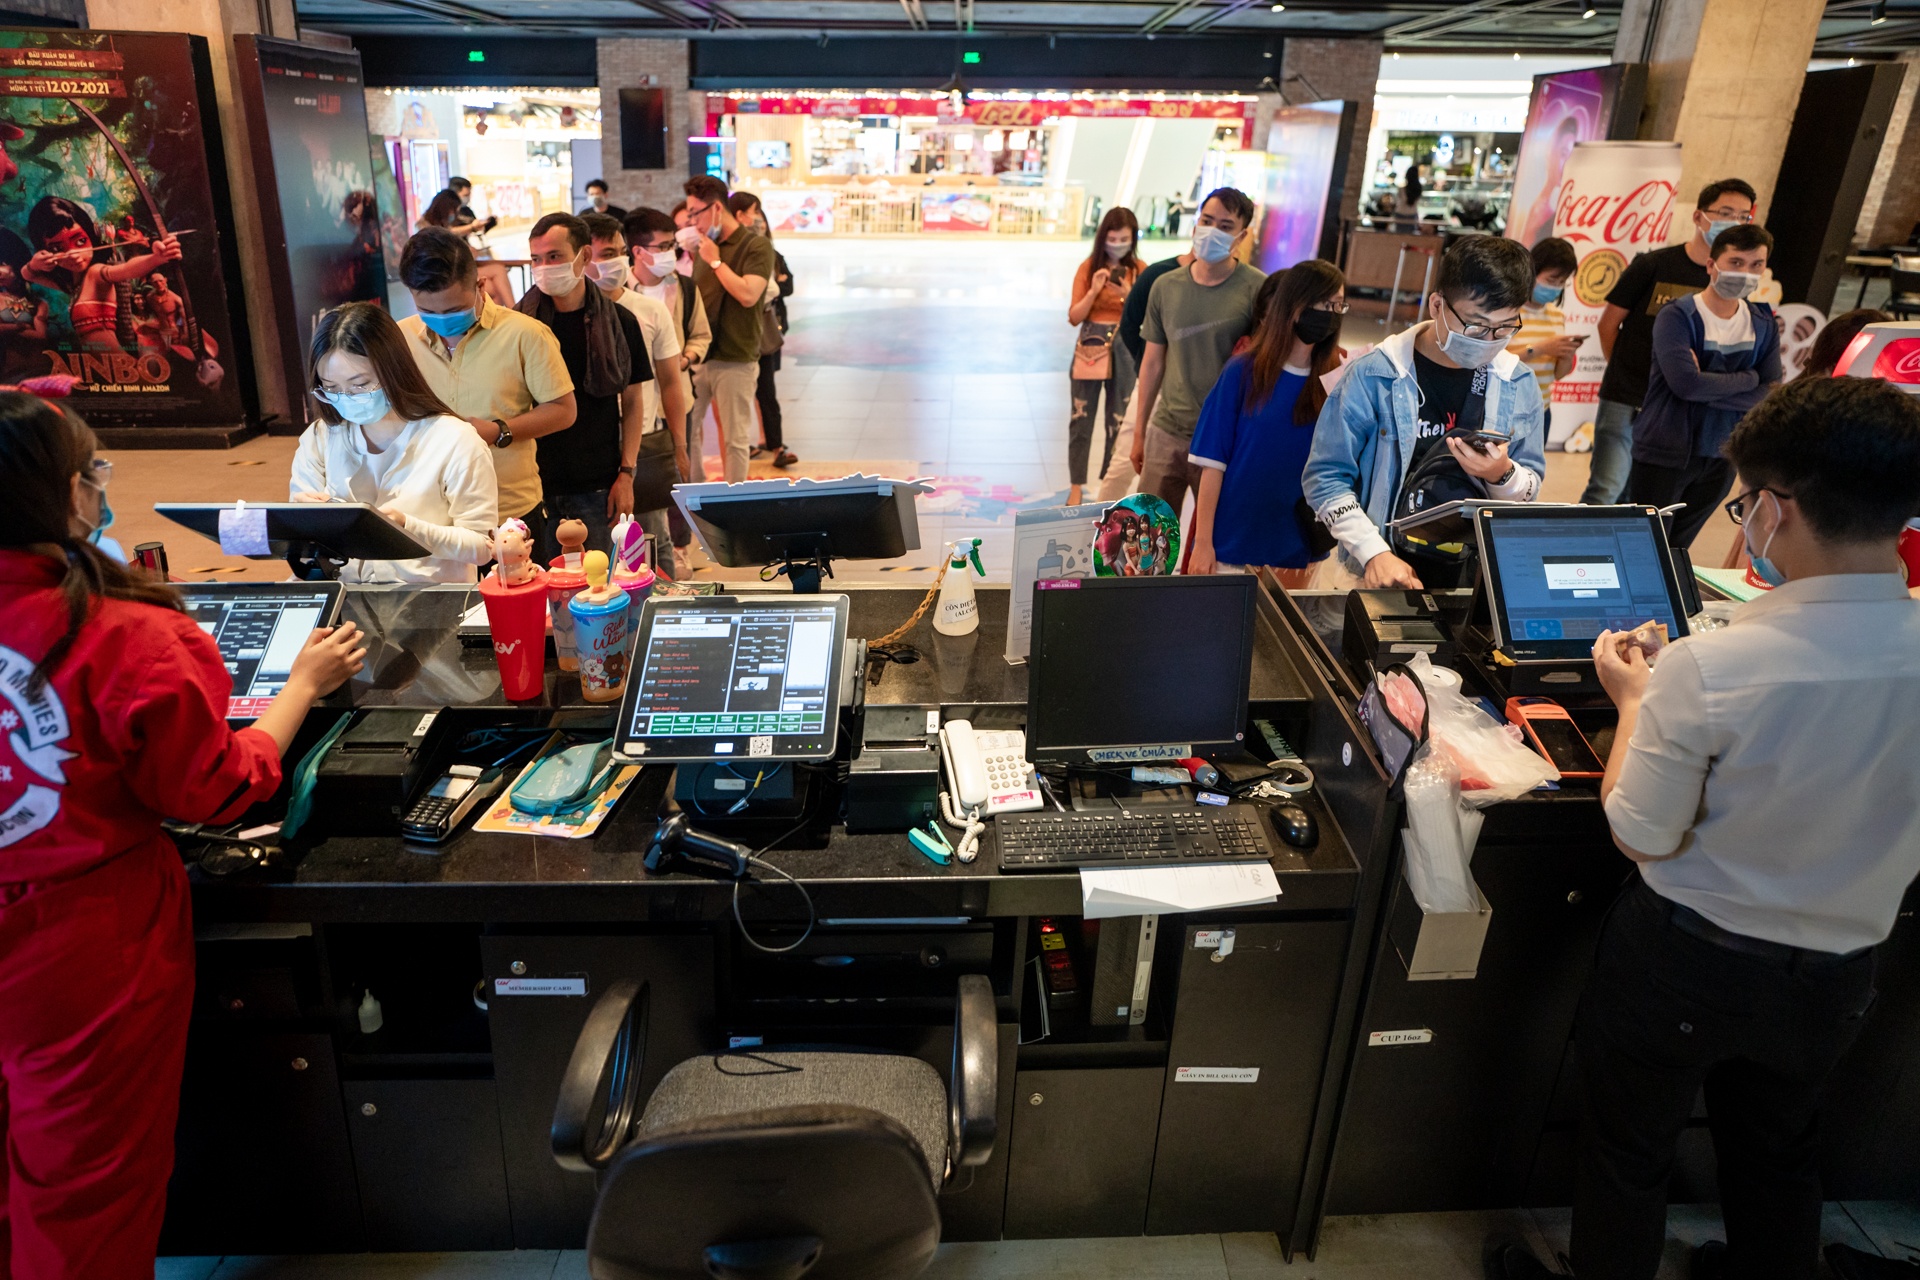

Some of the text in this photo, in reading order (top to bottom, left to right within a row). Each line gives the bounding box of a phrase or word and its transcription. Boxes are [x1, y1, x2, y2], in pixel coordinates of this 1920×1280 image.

[46, 80, 110, 94] 12.02.2021
[603, 616, 626, 637] Ride
[593, 629, 627, 651] Wave
